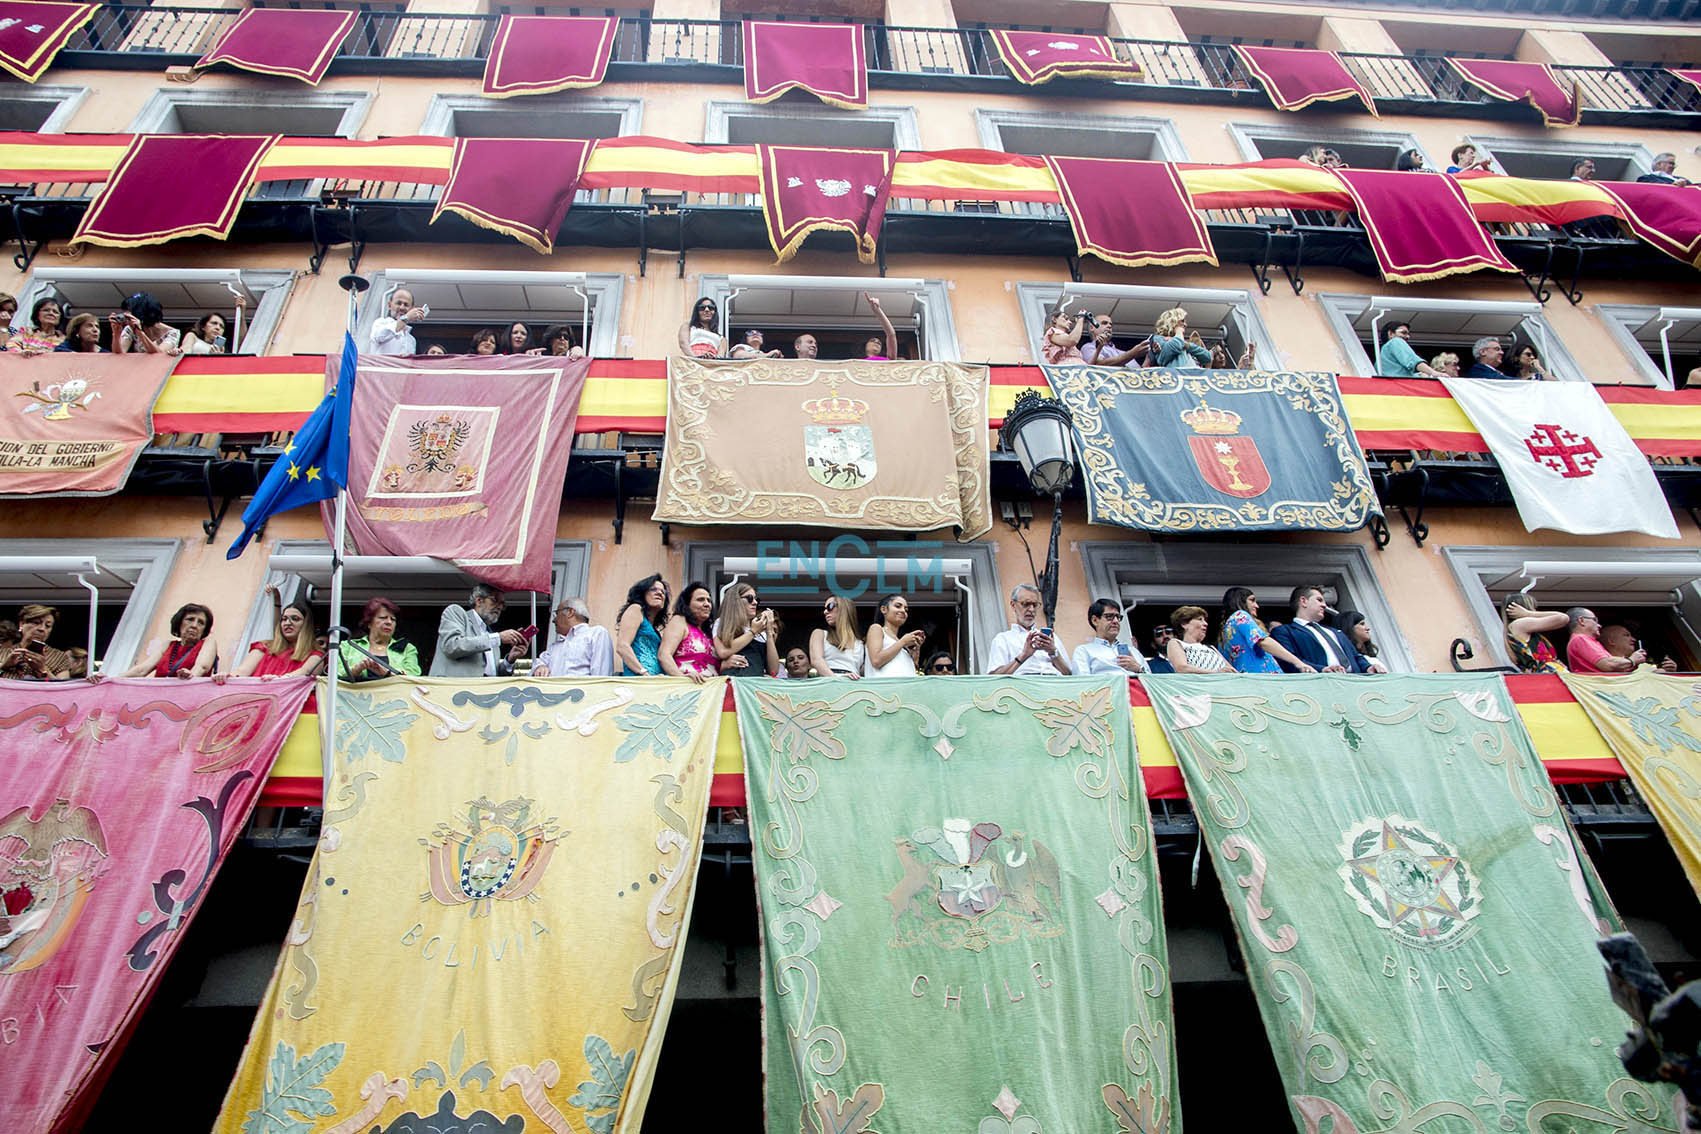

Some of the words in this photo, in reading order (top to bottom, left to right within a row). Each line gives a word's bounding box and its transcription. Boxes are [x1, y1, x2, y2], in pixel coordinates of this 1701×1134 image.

[27, 443, 48, 455] DEL
[56, 443, 113, 455] GOBIERNO
[49, 455, 96, 467] MANCHA
[400, 919, 552, 970] BOLIVIA
[1382, 936, 1512, 996] BRASIL
[911, 961, 1054, 1010] CHILE
